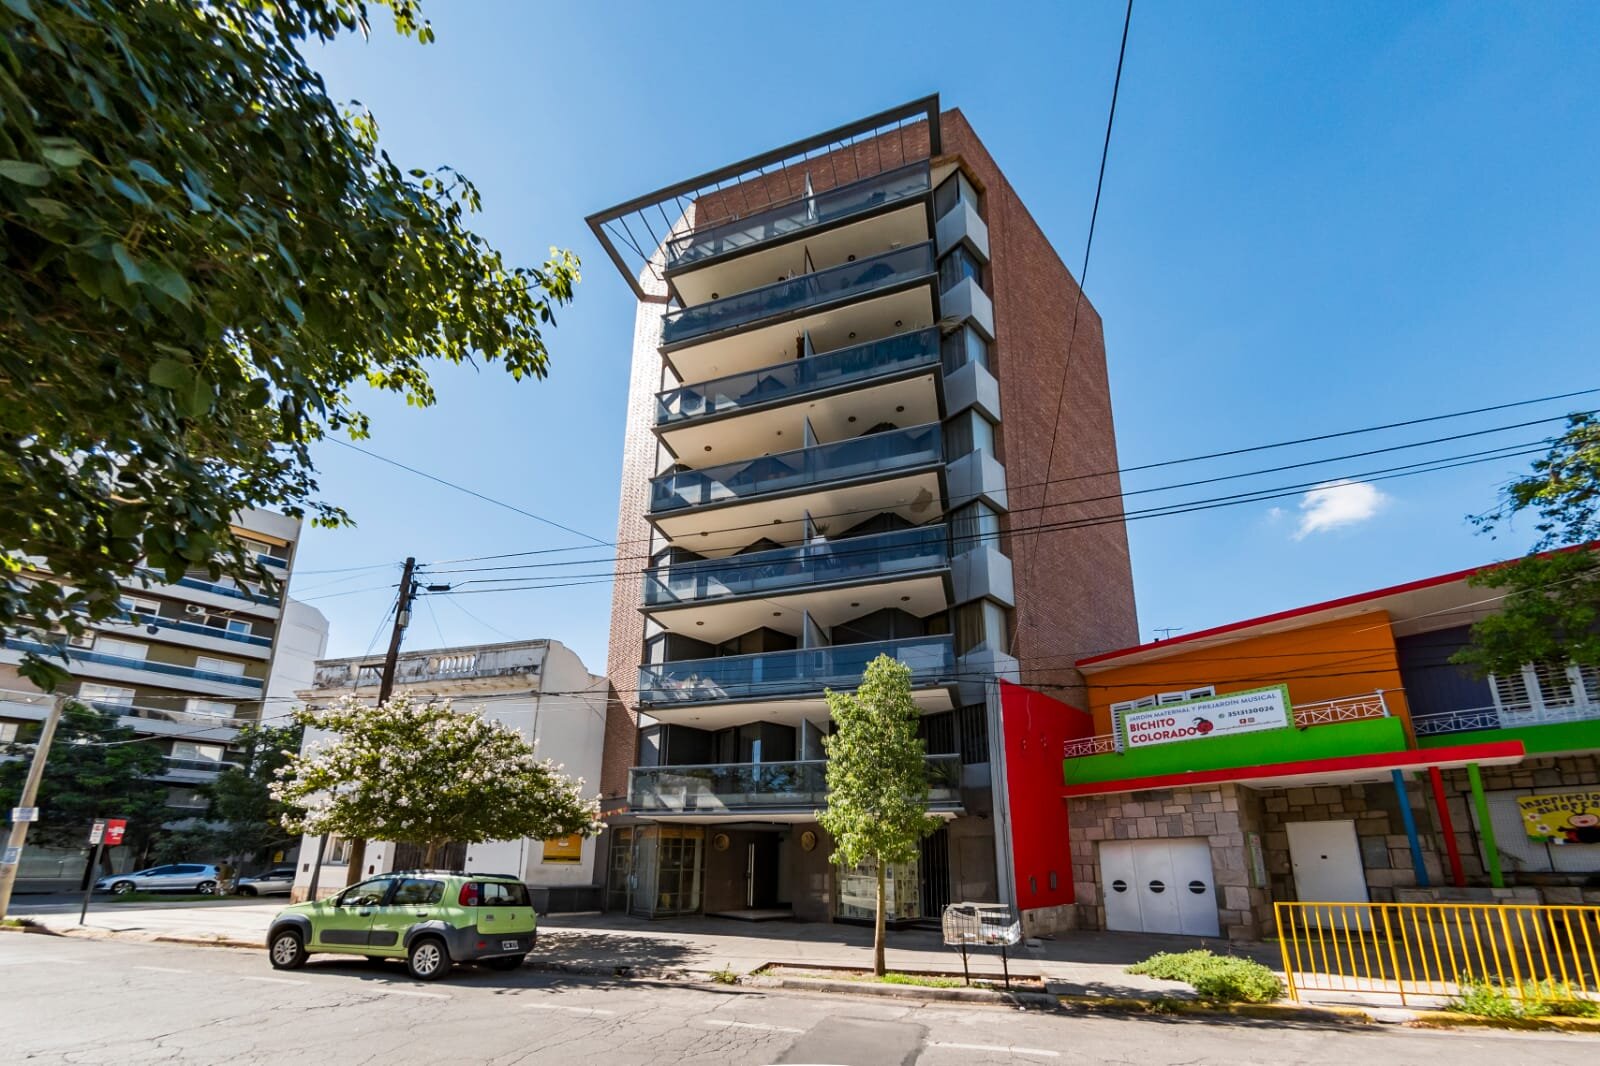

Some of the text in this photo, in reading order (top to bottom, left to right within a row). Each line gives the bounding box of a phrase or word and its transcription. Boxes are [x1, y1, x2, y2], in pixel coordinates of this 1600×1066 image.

[1129, 713, 1153, 722] JARDÍN
[1153, 707, 1190, 718] MATERNAL
[1241, 693, 1277, 704] MUSICAL
[1129, 717, 1176, 733] BICHITO
[1131, 726, 1197, 744] COLORADO
